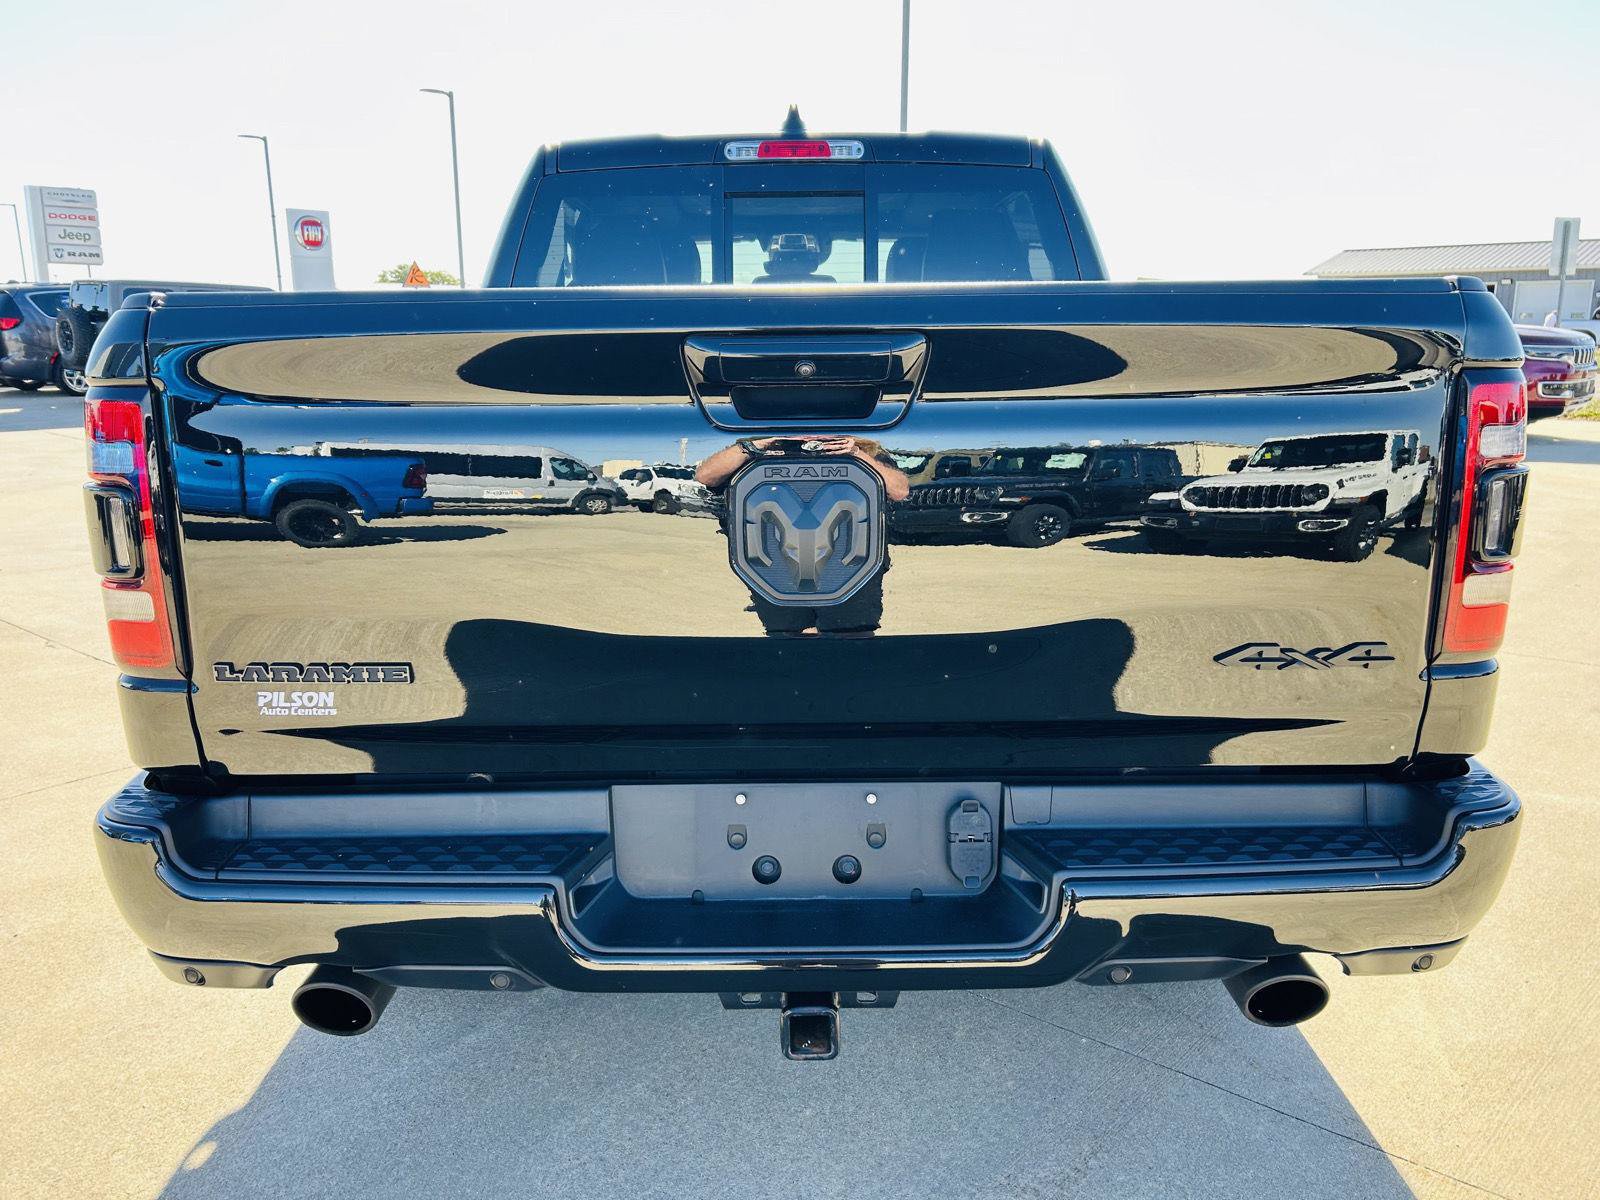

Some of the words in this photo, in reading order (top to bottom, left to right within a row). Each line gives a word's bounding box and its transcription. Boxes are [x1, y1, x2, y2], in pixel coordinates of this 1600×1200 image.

[48, 213, 96, 221] DODGE
[58, 229, 91, 242] Jeep
[303, 225, 321, 241] FIAT
[764, 466, 848, 479] RAM
[213, 662, 414, 684] LARAMIE
[257, 692, 335, 707] PILSON
[259, 707, 289, 716] Auto
[291, 707, 338, 716] Centers
